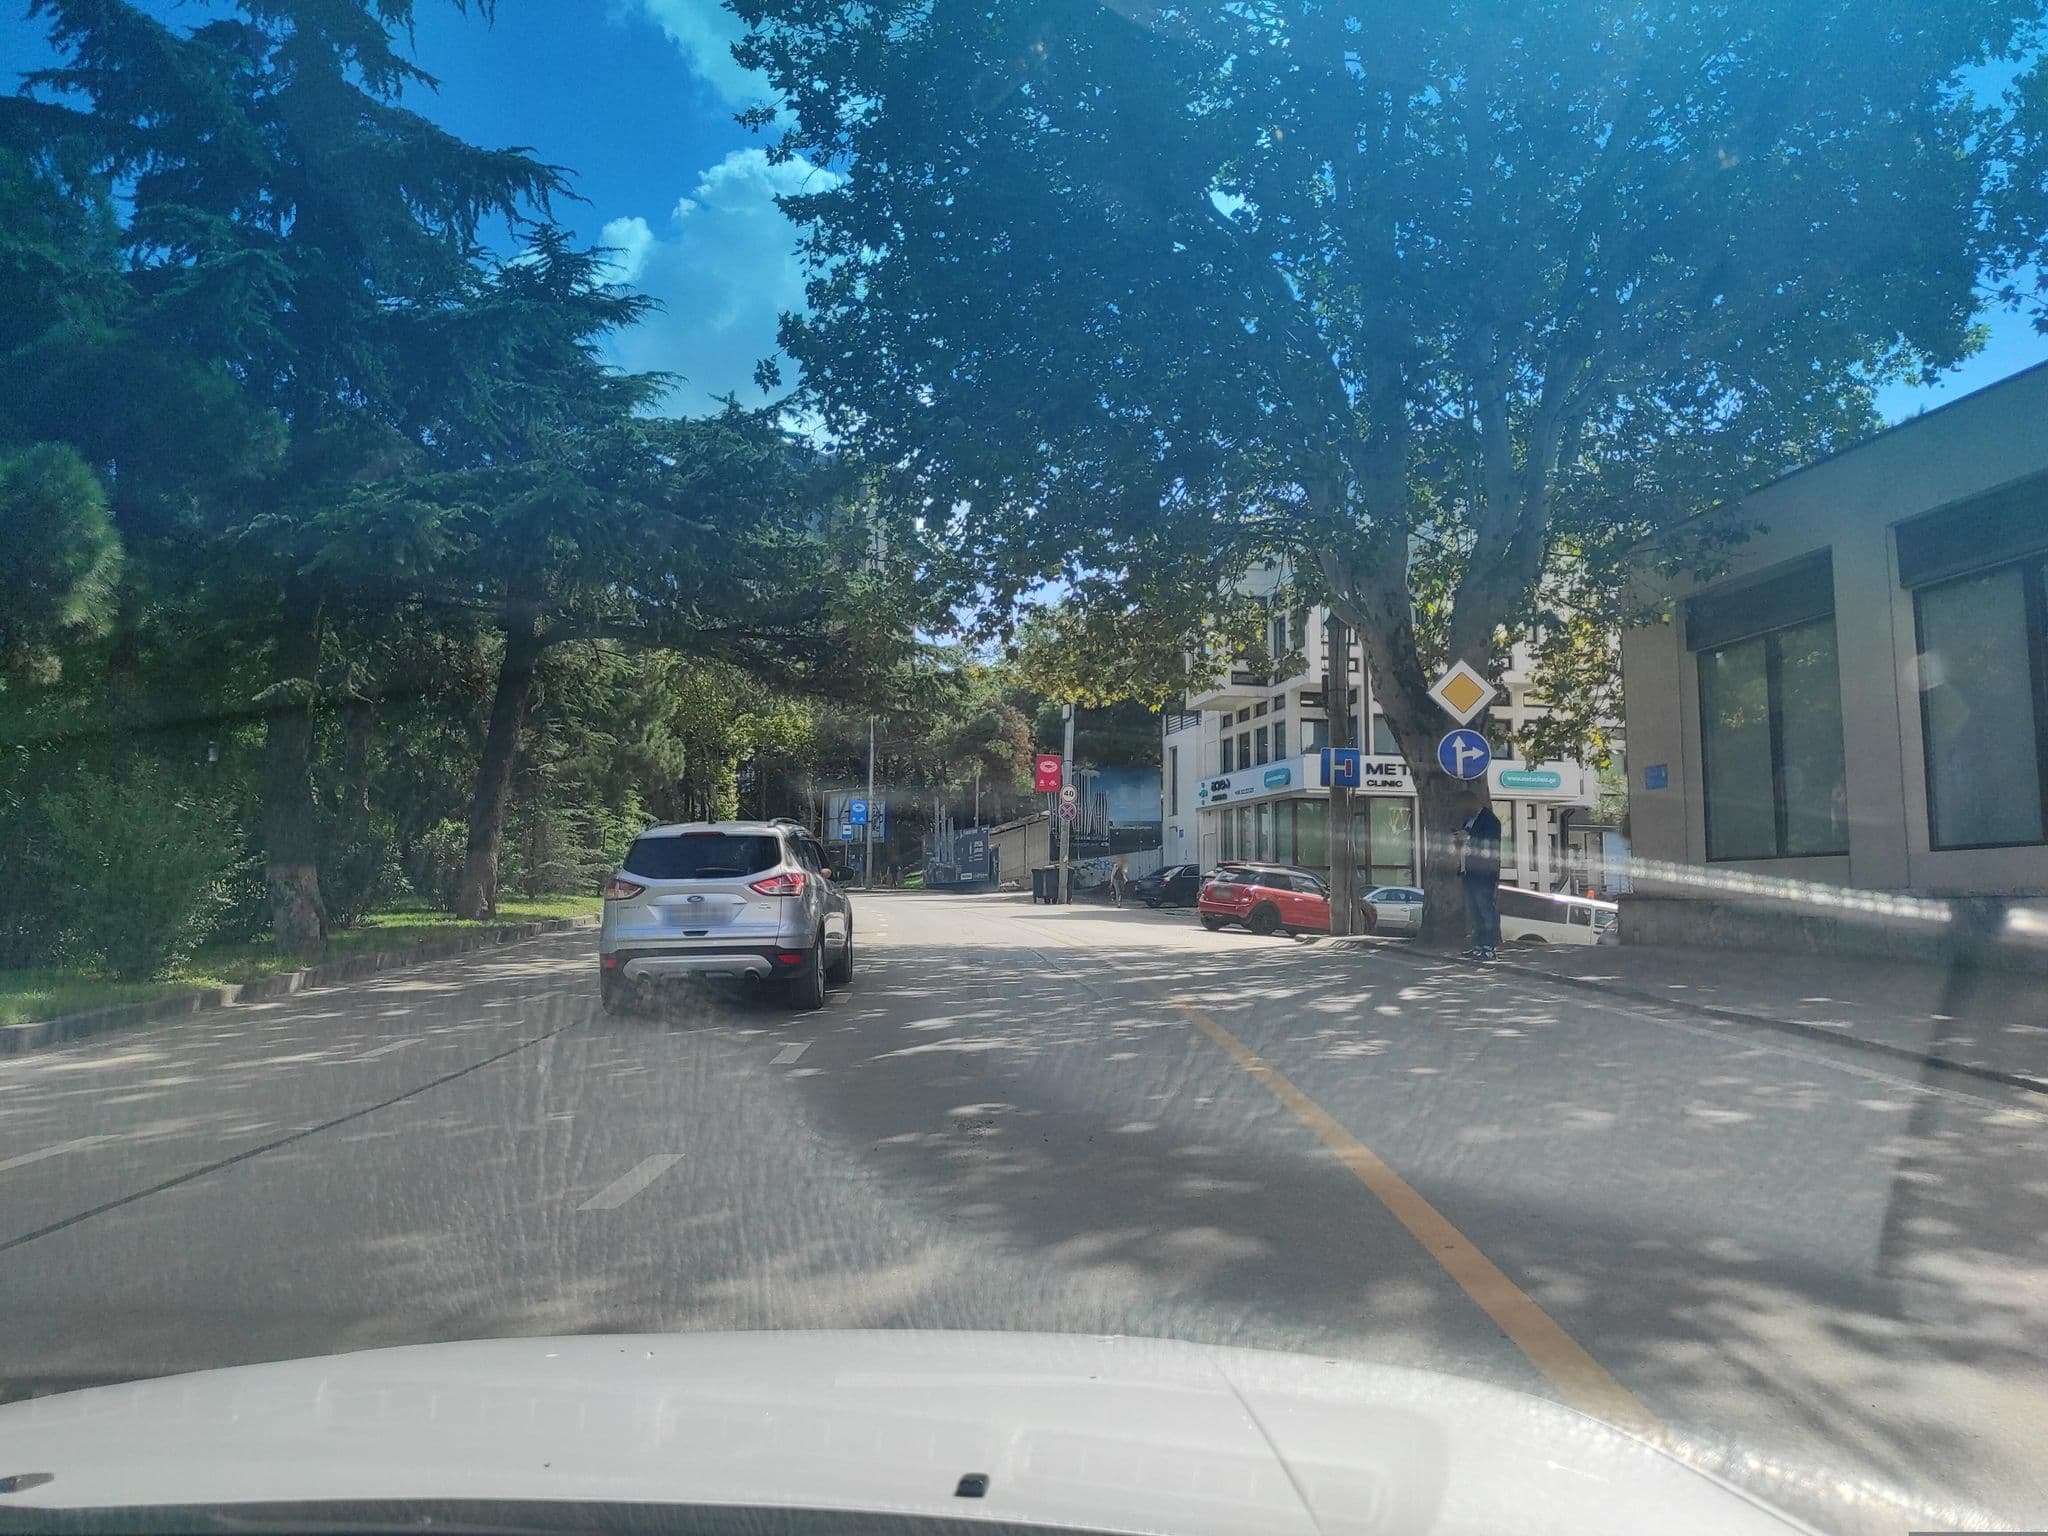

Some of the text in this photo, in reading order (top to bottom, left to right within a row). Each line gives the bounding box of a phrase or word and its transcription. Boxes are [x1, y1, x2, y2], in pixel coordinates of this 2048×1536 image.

[1366, 763, 1412, 776] MET
[1366, 779, 1404, 788] CLINIC
[1063, 790, 1074, 798] 40
